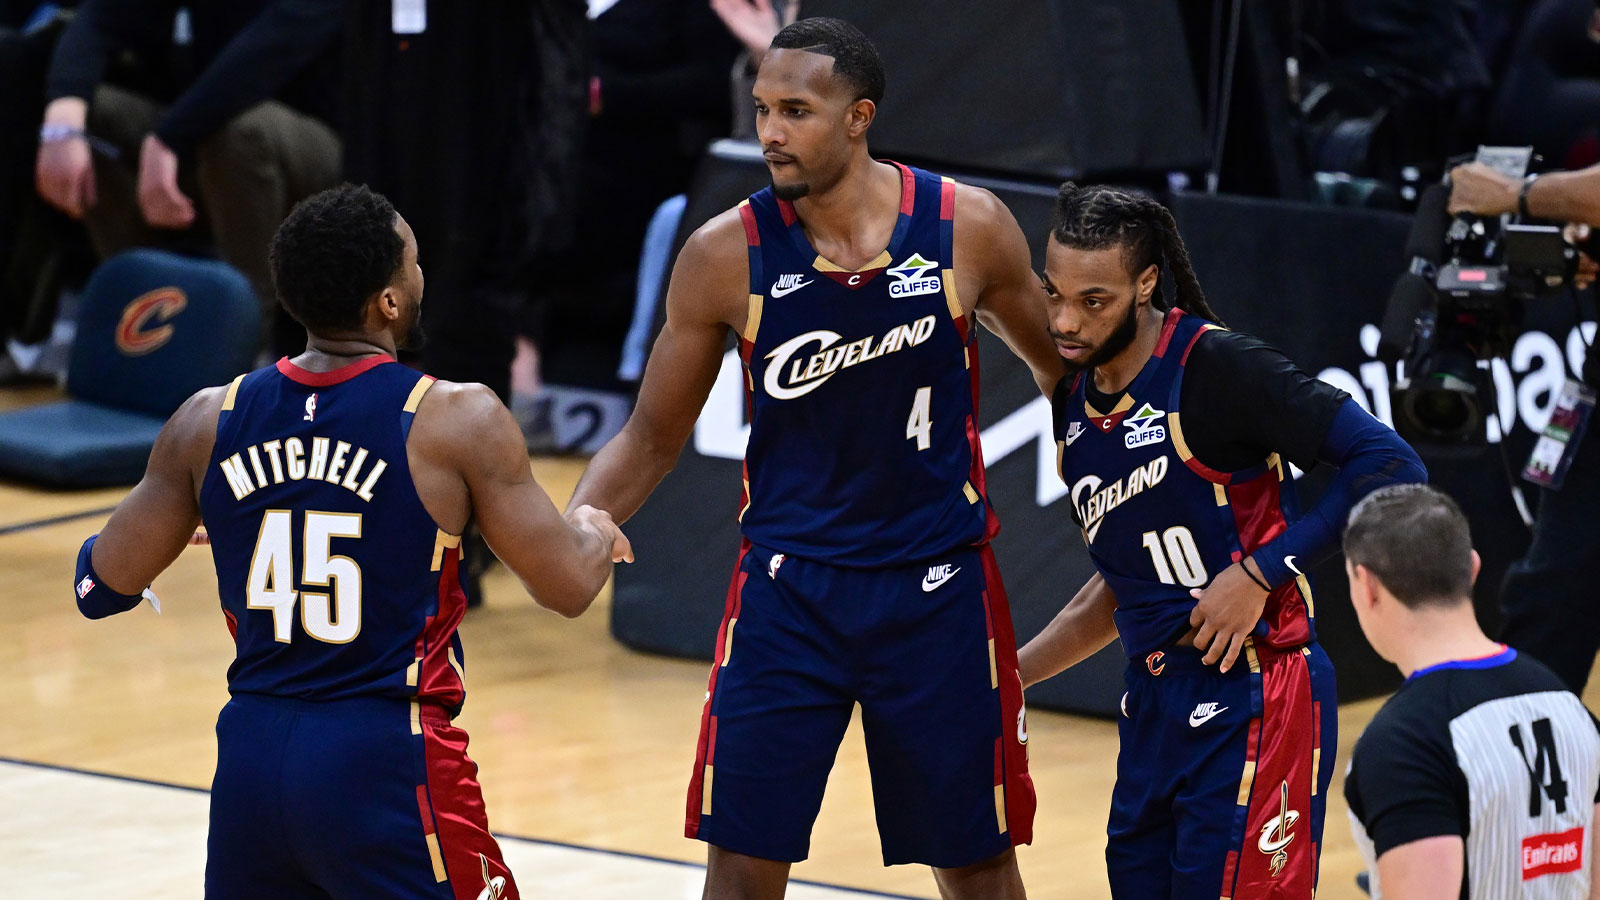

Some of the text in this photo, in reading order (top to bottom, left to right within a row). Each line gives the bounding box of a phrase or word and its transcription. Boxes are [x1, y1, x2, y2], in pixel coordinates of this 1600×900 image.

[777, 274, 804, 288] NIKE
[891, 279, 940, 294] CLIFFS
[763, 314, 936, 400] CLEVELAND
[906, 386, 933, 451] 4
[1127, 428, 1164, 445] CLIFFS
[219, 437, 388, 502] MITCHELL
[1071, 455, 1168, 544] CLEVELAND
[246, 509, 362, 644] 45
[927, 563, 952, 582] NIKE
[1142, 525, 1208, 587] 10
[1508, 717, 1568, 818] 14
